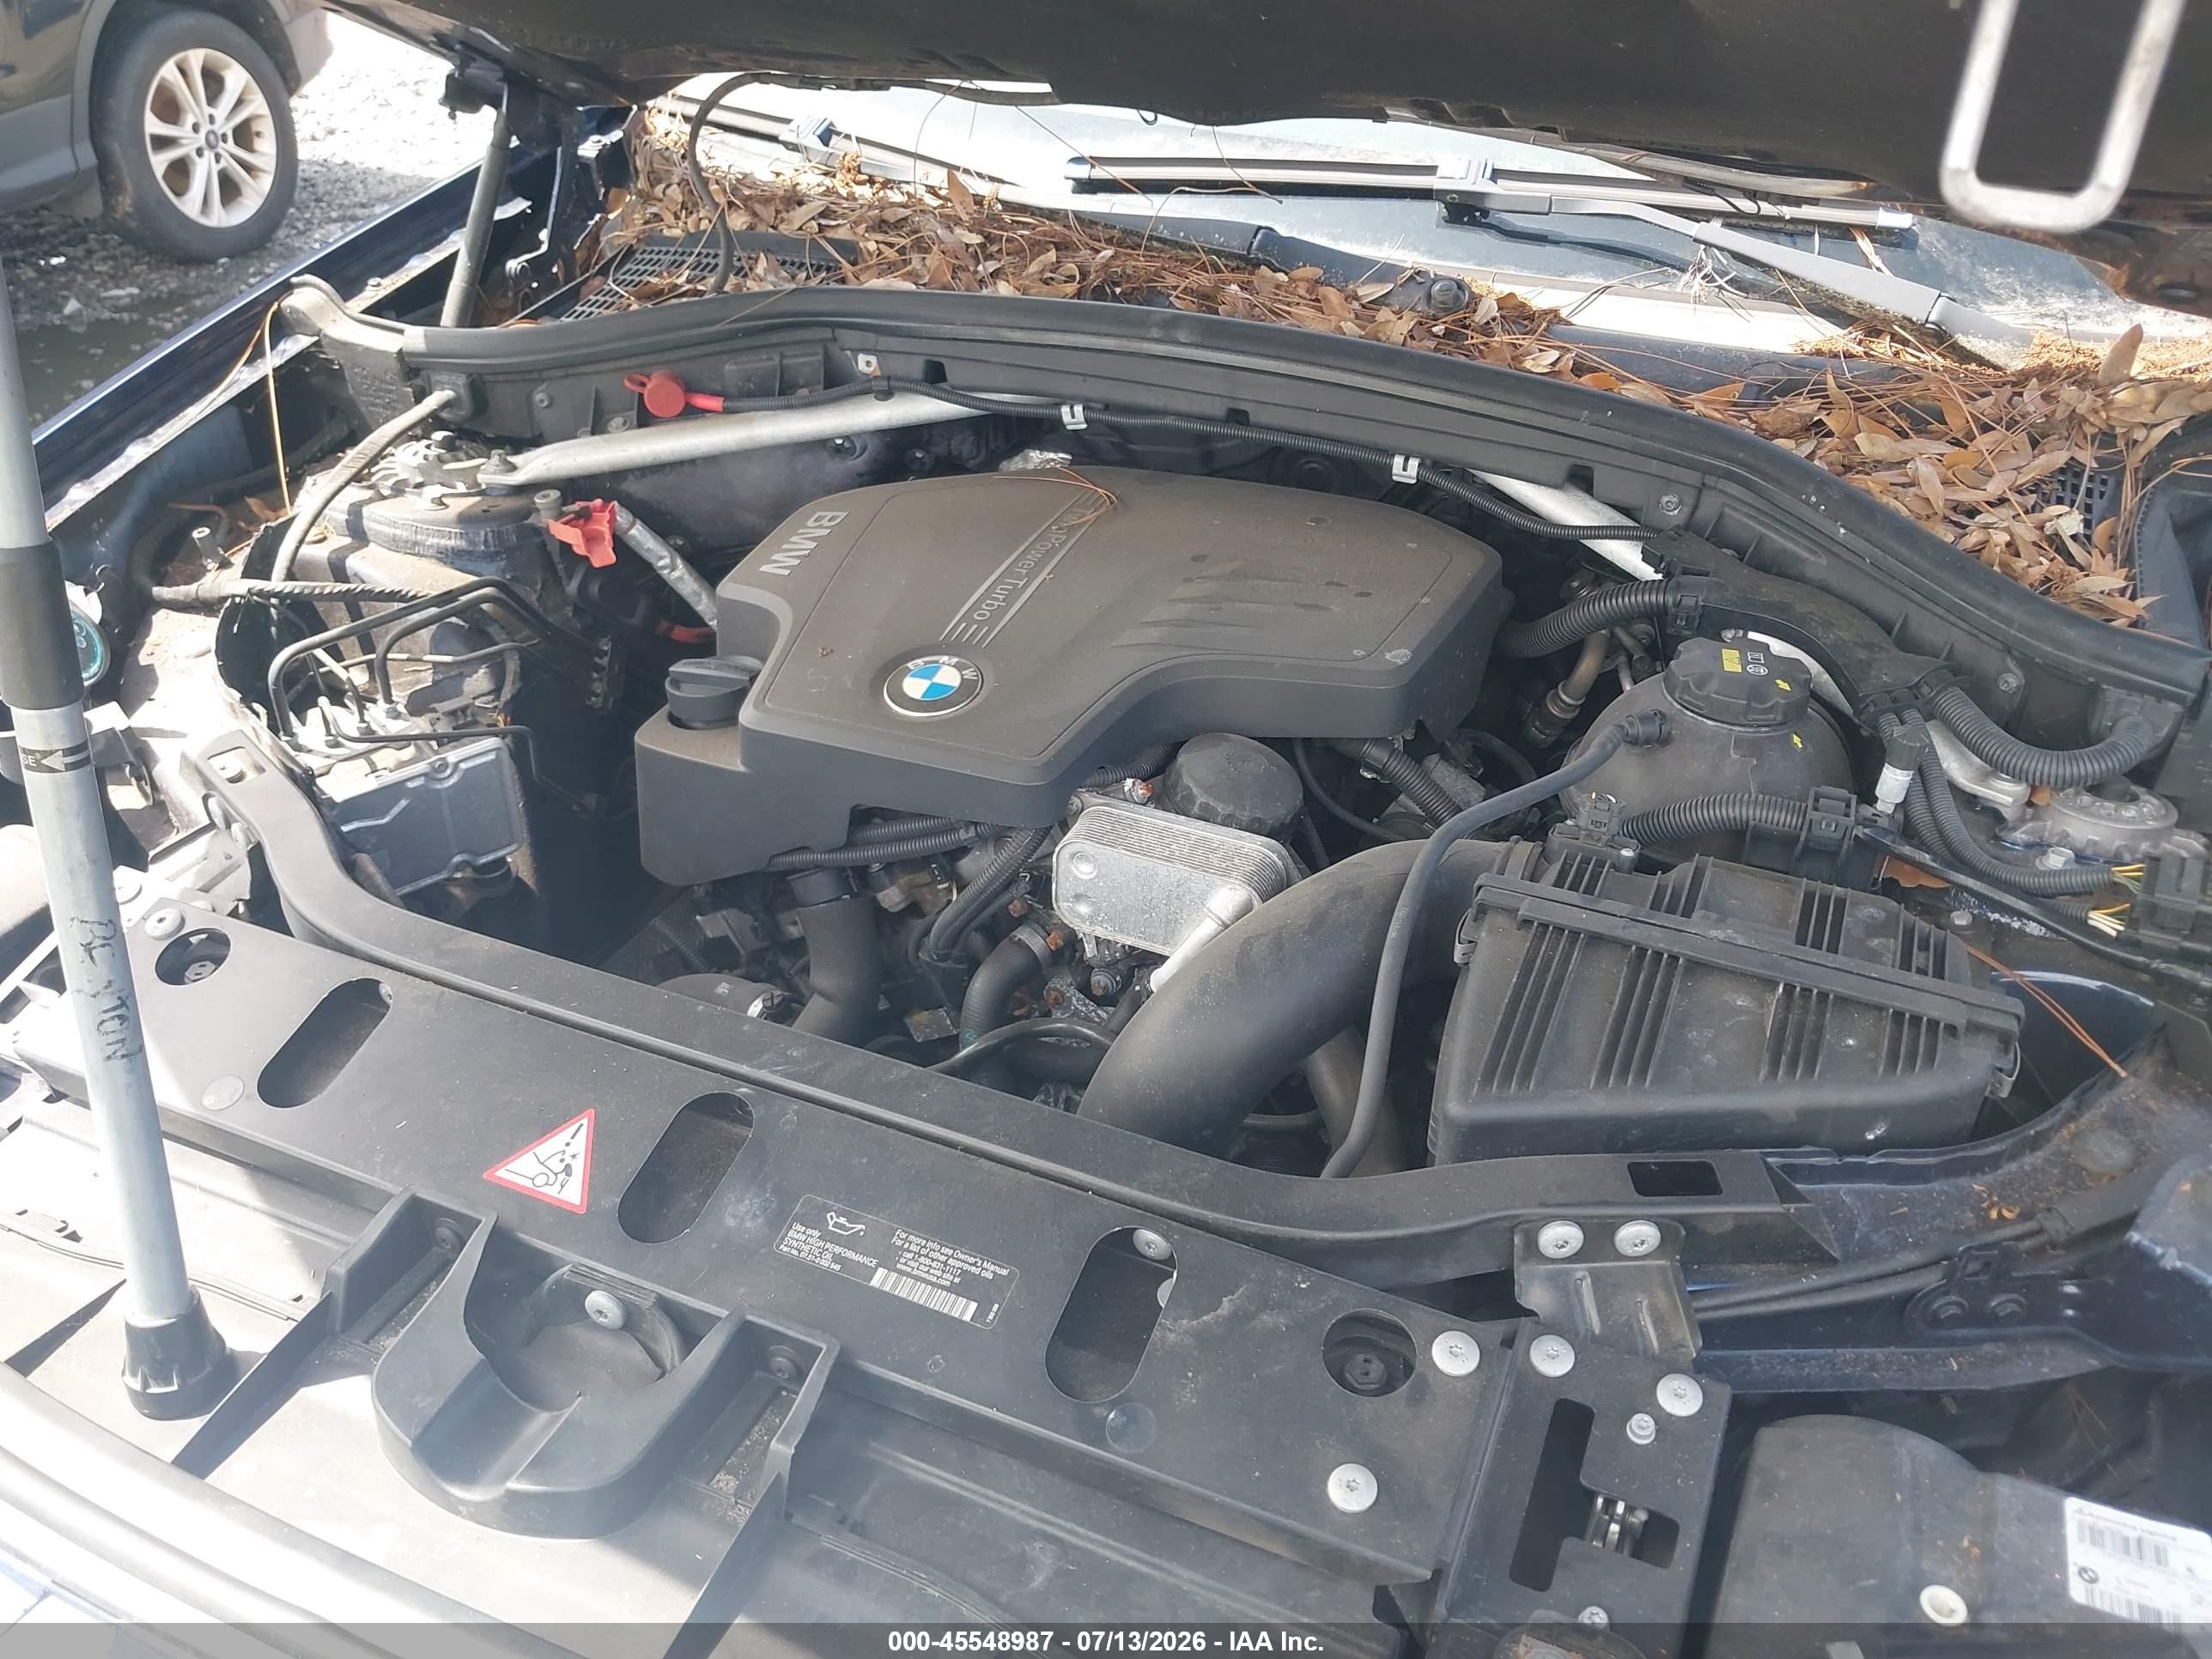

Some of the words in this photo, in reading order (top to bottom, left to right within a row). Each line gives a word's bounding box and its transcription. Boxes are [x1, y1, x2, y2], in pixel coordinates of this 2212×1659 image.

[759, 509, 849, 577] BMW
[972, 576, 1030, 621] Turbo
[906, 655, 979, 682] BMW
[782, 1237, 823, 1257] SYNTHETIC
[821, 1250, 834, 1261] OIL
[787, 1229, 808, 1242] BMW
[805, 1236, 826, 1249] HIGH
[823, 1242, 878, 1267] PERFORMANCE
[792, 1222, 806, 1233] Use
[805, 1228, 822, 1238] only
[890, 1236, 904, 1247] For
[920, 1247, 930, 1255] of
[928, 1250, 949, 1261] other
[947, 1257, 982, 1274] approved
[981, 1269, 994, 1279] oils
[895, 1229, 908, 1239] For
[907, 1235, 927, 1246] more
[926, 1239, 941, 1251] info
[939, 1246, 953, 1256] see
[953, 1249, 983, 1267] Owner's
[981, 1260, 1011, 1276] Manual
